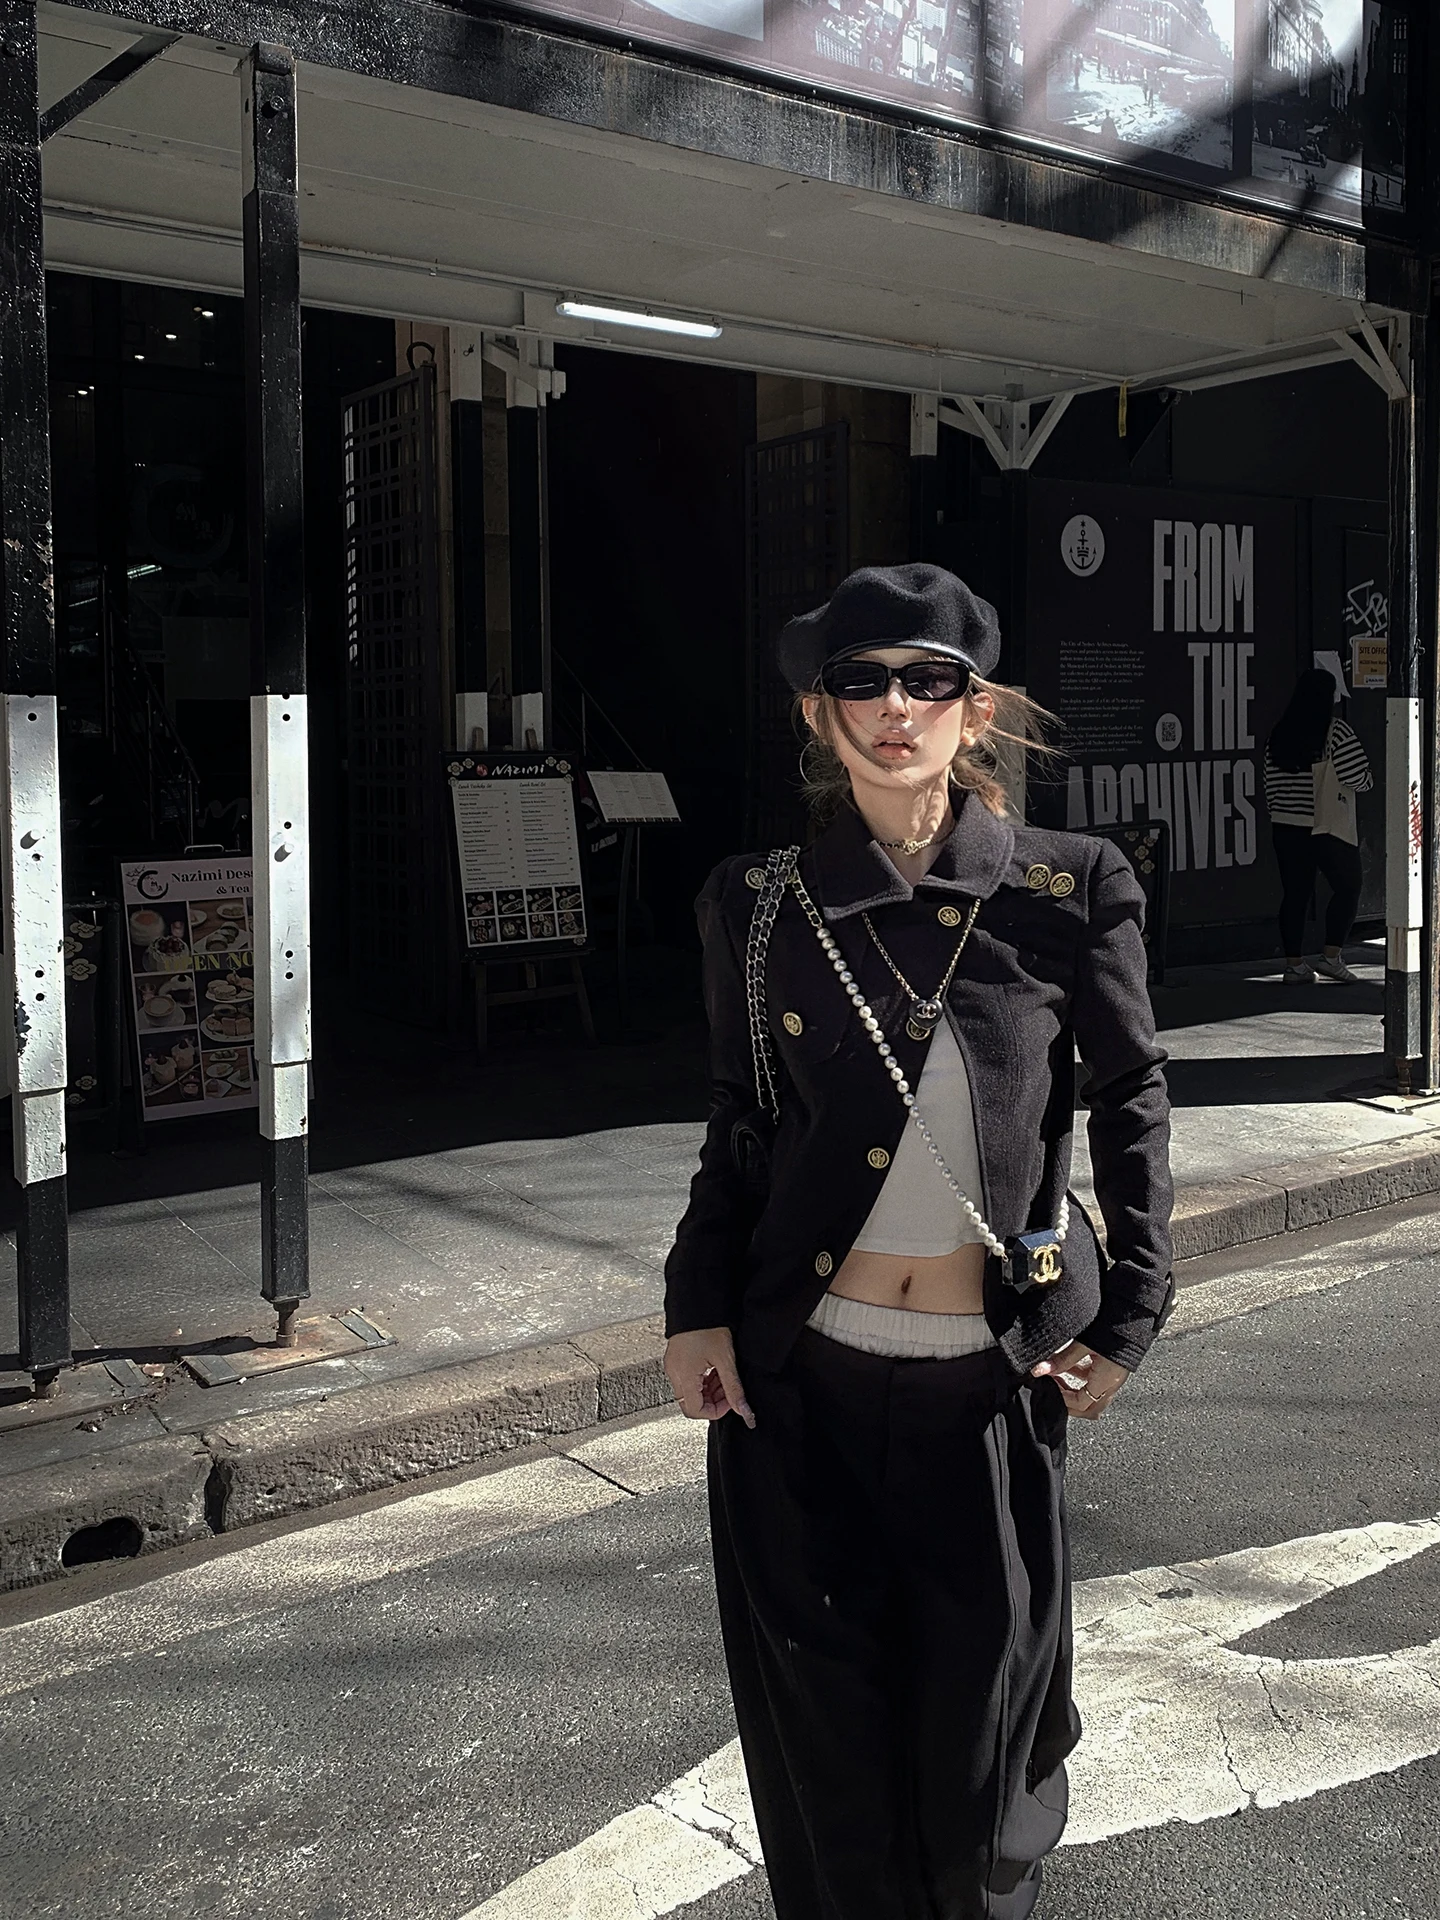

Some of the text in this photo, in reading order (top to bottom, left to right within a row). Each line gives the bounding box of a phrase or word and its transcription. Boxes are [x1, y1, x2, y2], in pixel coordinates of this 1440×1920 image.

[1153, 519, 1254, 632] FROM
[1359, 646, 1371, 655] SITE
[1188, 642, 1255, 751] THE
[171, 868, 253, 883] Nazimi Des
[216, 885, 250, 895] & Tea
